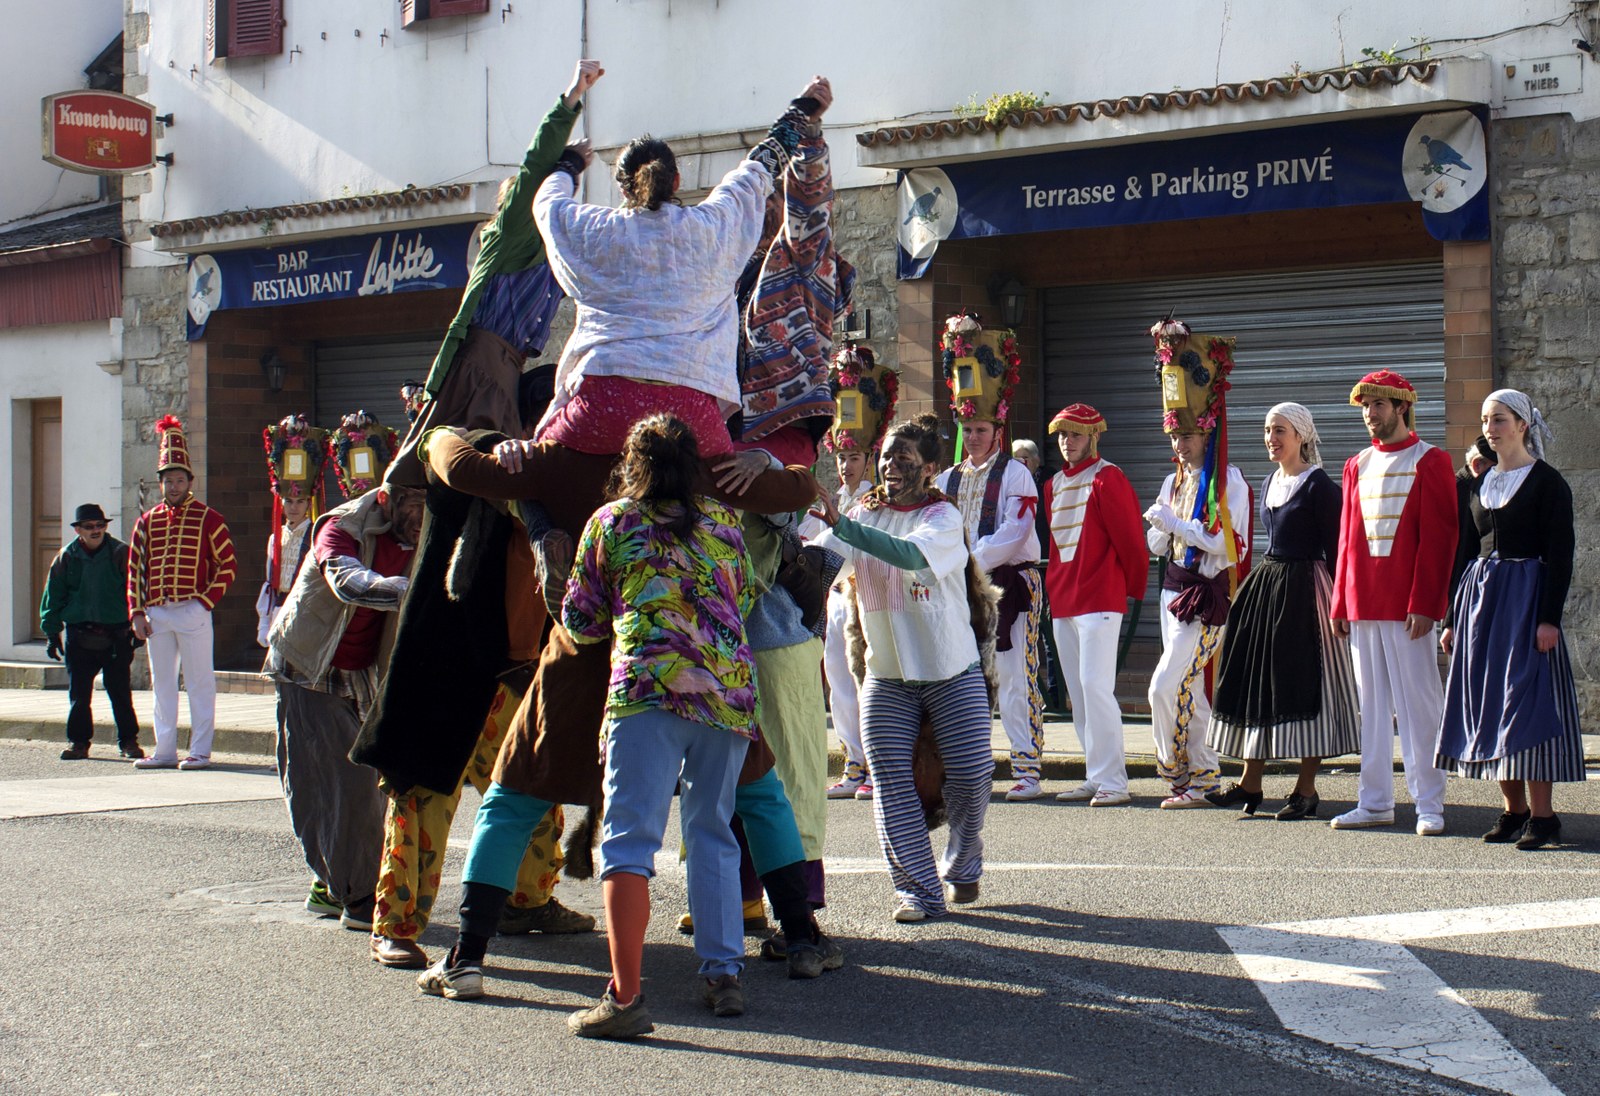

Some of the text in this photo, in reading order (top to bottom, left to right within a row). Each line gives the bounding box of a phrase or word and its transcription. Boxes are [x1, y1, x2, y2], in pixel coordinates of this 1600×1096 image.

[1532, 62, 1551, 73] RUE
[1524, 77, 1559, 91] THIERS
[58, 103, 148, 137] Kronenbourg
[1022, 147, 1333, 209] Terrasse & Parking PRIVÉ
[277, 250, 309, 273] BAR
[357, 232, 444, 297] Lafitte
[252, 270, 353, 301] RESTAURANT
